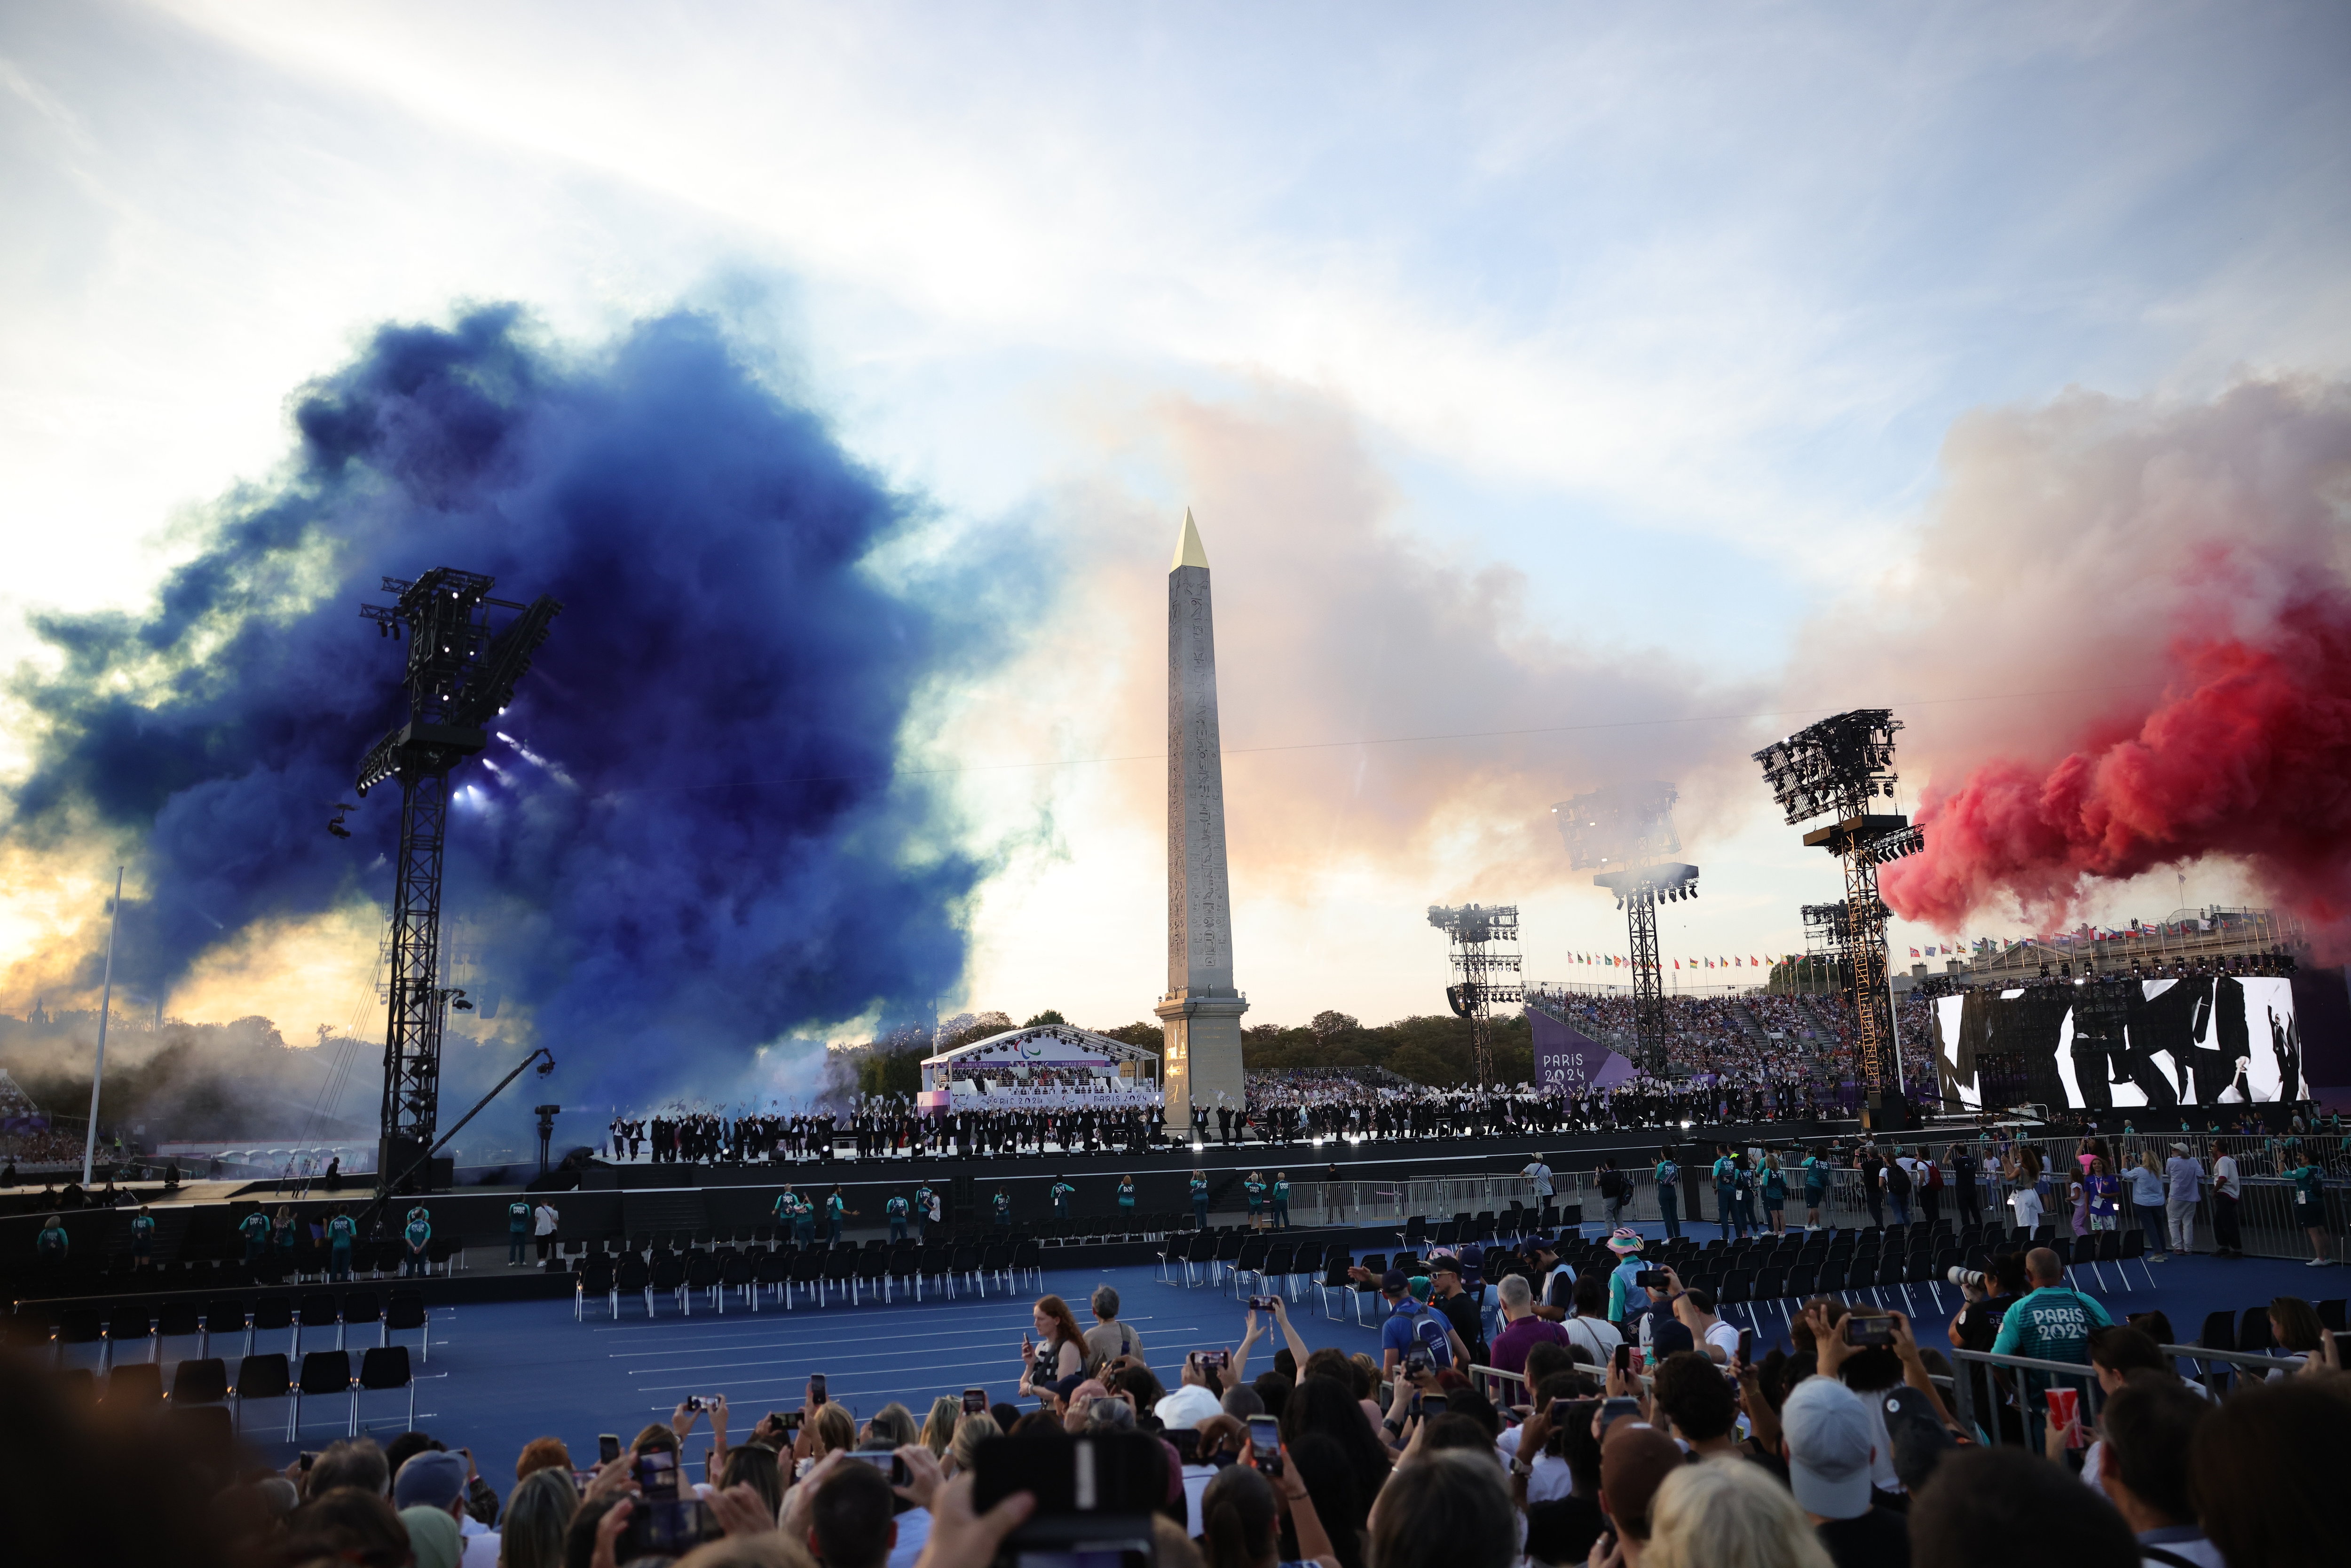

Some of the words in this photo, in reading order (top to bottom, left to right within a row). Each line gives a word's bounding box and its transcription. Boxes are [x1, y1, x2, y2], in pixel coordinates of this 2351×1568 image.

[1543, 1053, 1583, 1067] PARIS
[1545, 1068, 1585, 1082] 2024
[2032, 1308, 2085, 1324] PARIS
[2037, 1323, 2089, 1341] 2024
